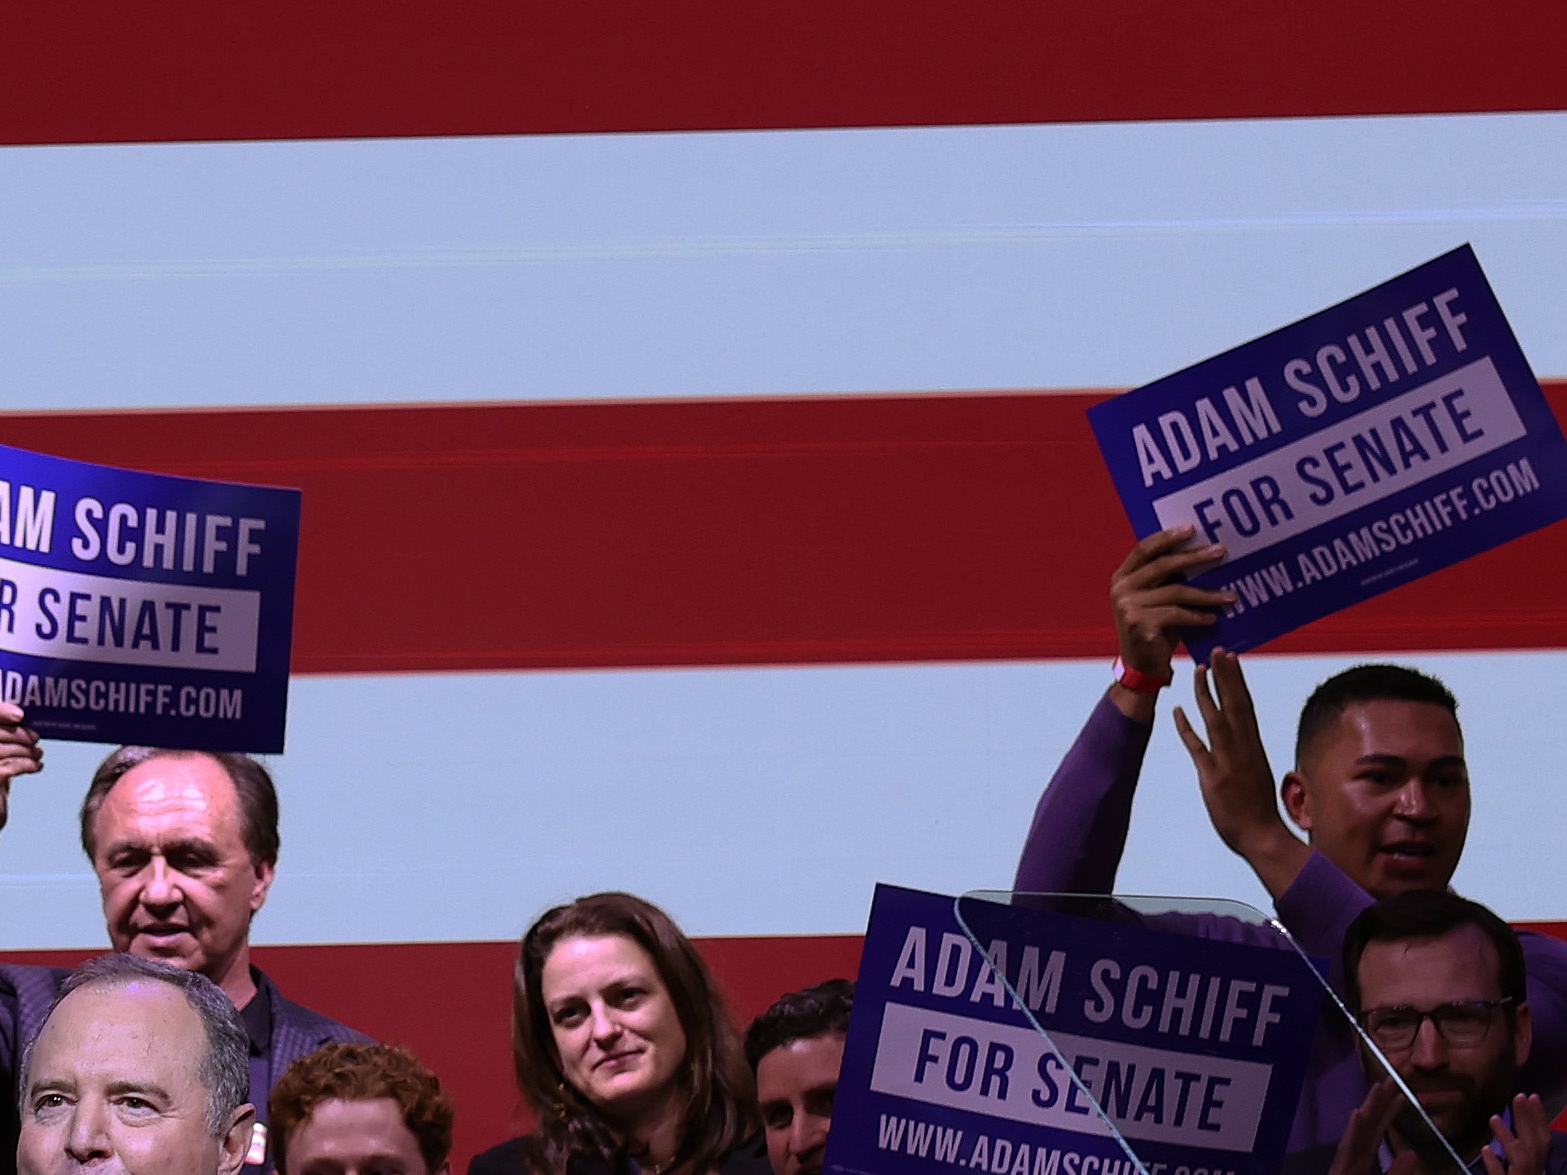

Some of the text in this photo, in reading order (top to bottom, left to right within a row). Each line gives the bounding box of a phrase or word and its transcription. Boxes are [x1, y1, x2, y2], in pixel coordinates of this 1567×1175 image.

[1133, 287, 1468, 487] ADAM SCHIFF
[1193, 388, 1485, 545] FOR SENATE
[71, 497, 266, 576] SCHIFF
[35, 587, 222, 656] SENATE
[890, 926, 1290, 1048] ADAM SCHIFF
[914, 1028, 1232, 1132] FOR SENATE
